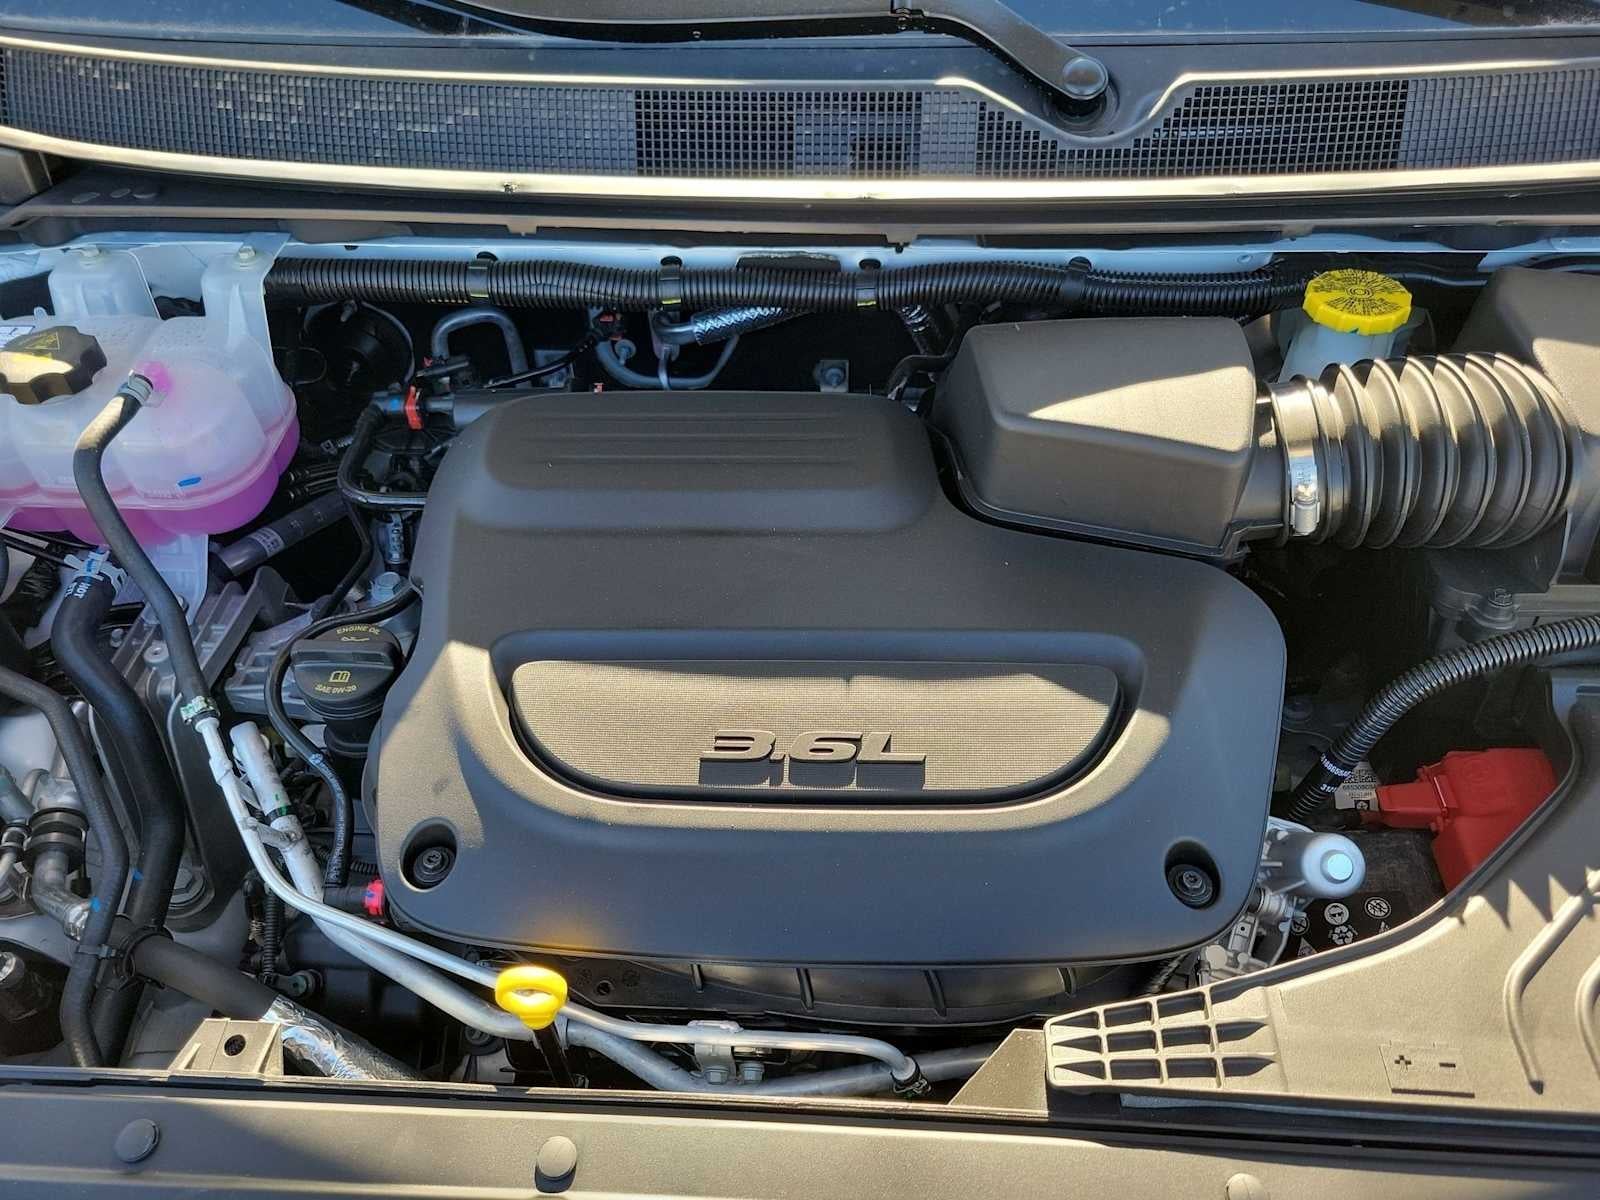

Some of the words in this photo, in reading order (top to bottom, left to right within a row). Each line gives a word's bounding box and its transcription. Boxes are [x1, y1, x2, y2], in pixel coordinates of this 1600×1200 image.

[73, 582, 91, 599] HOT
[336, 625, 369, 634] ENGINE
[315, 684, 331, 693] SAE
[331, 684, 357, 694] 0W-20
[699, 729, 927, 764] 3.6L
